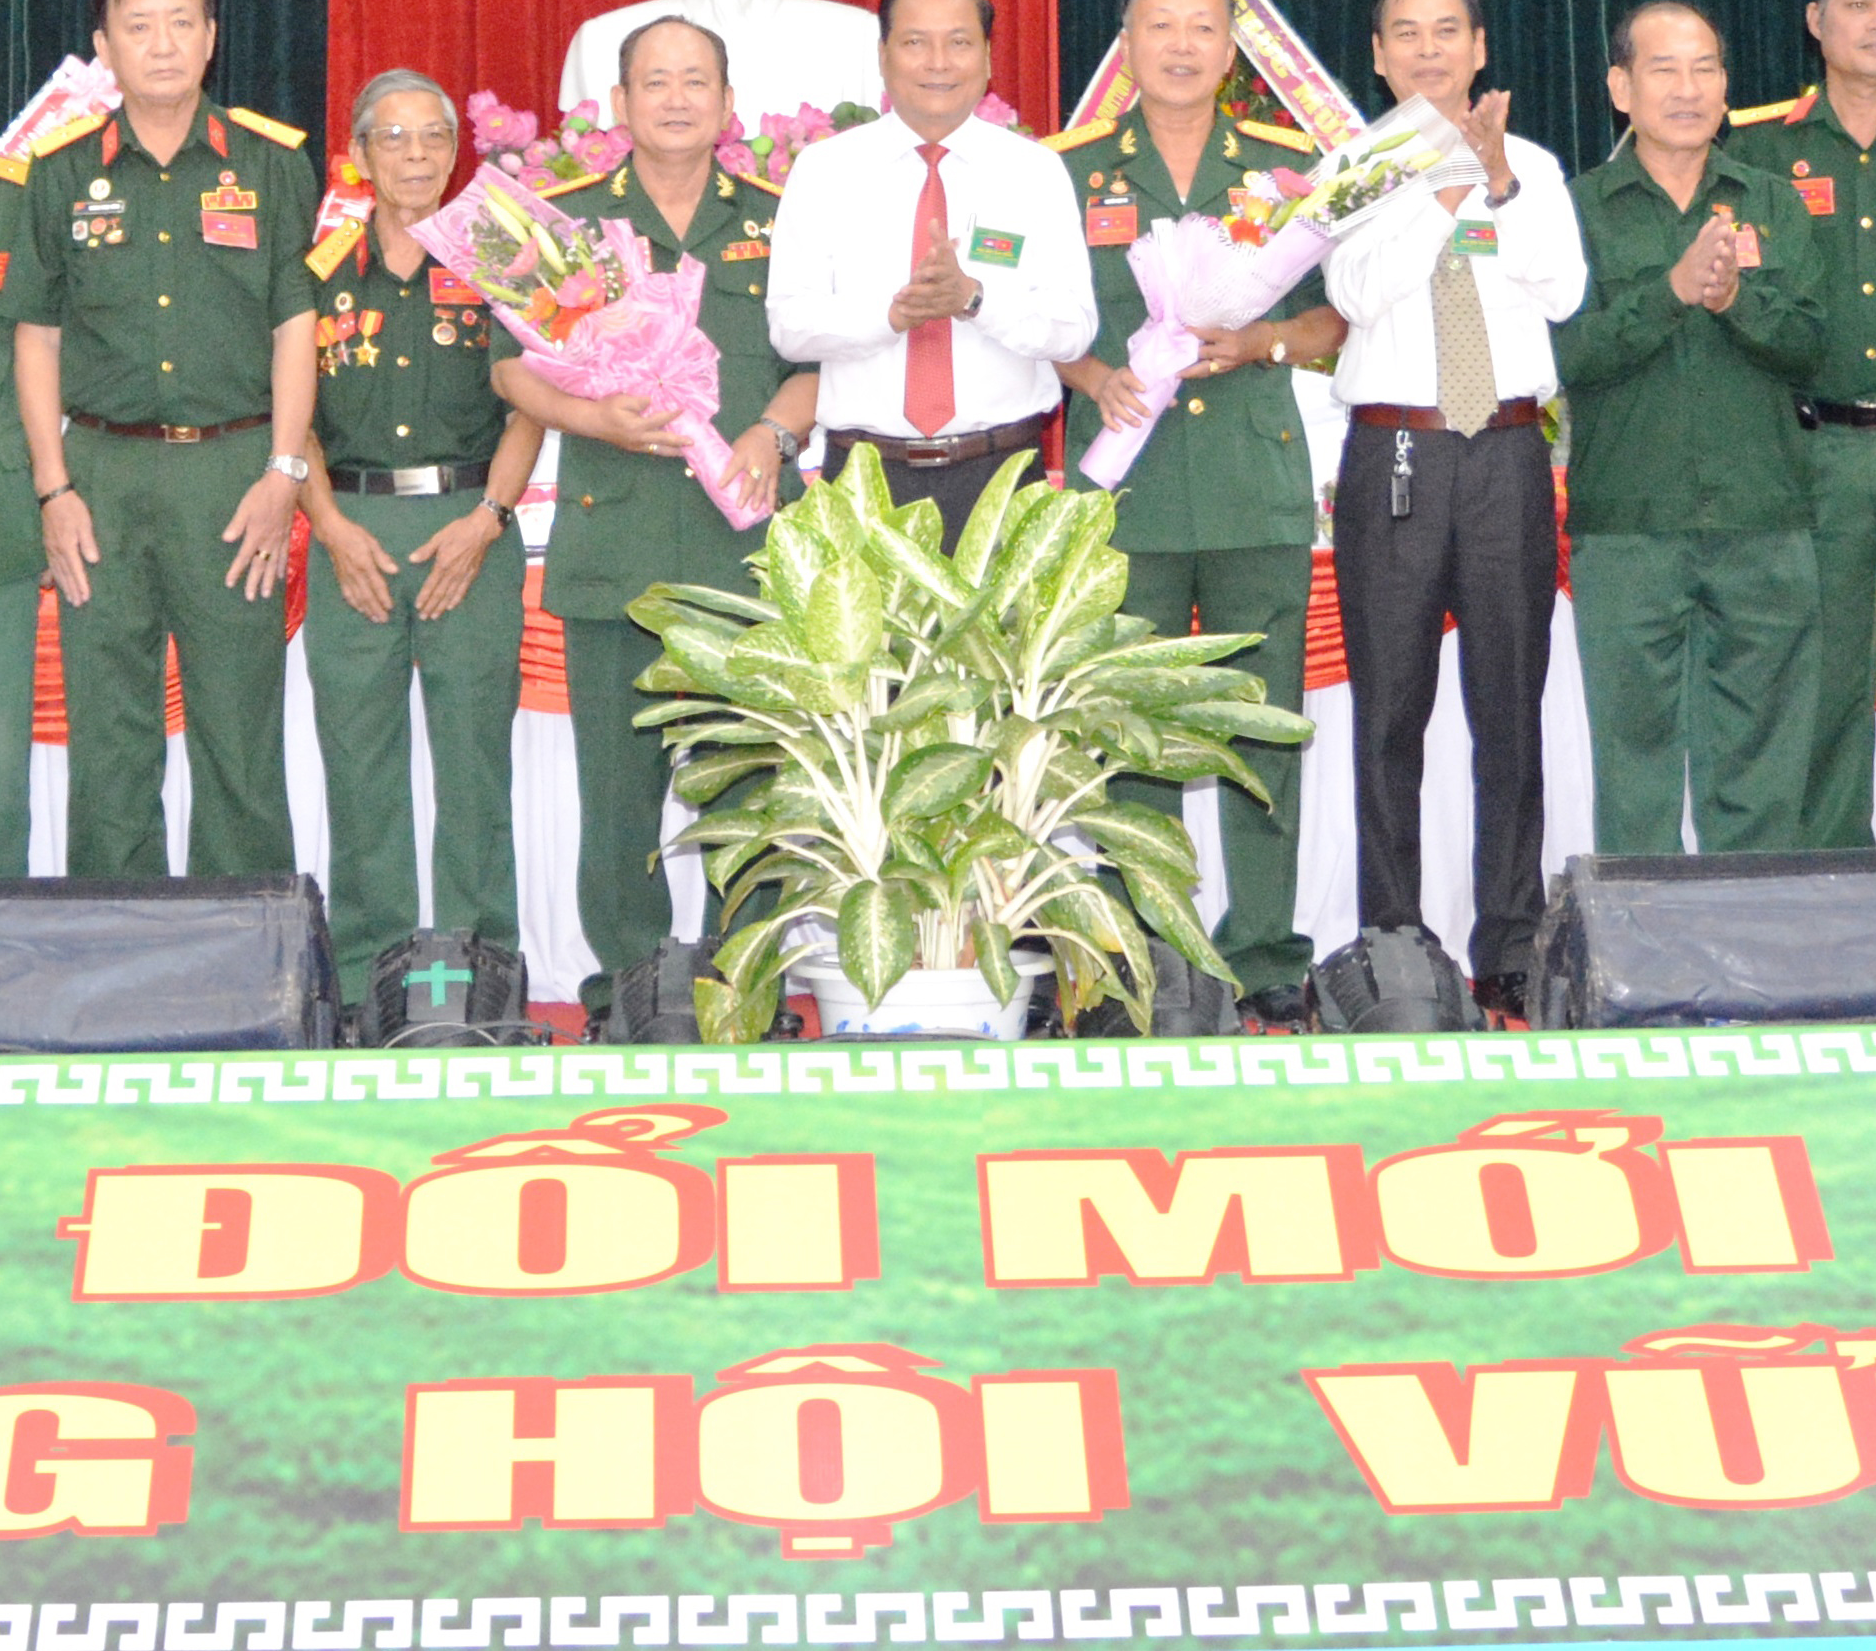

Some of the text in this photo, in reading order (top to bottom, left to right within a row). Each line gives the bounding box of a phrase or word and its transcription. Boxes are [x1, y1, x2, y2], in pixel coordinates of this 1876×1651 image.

[57, 1102, 882, 1303] ĐỔI
[974, 1108, 1836, 1290] MỚI
[398, 1340, 1130, 1562] HỘI
